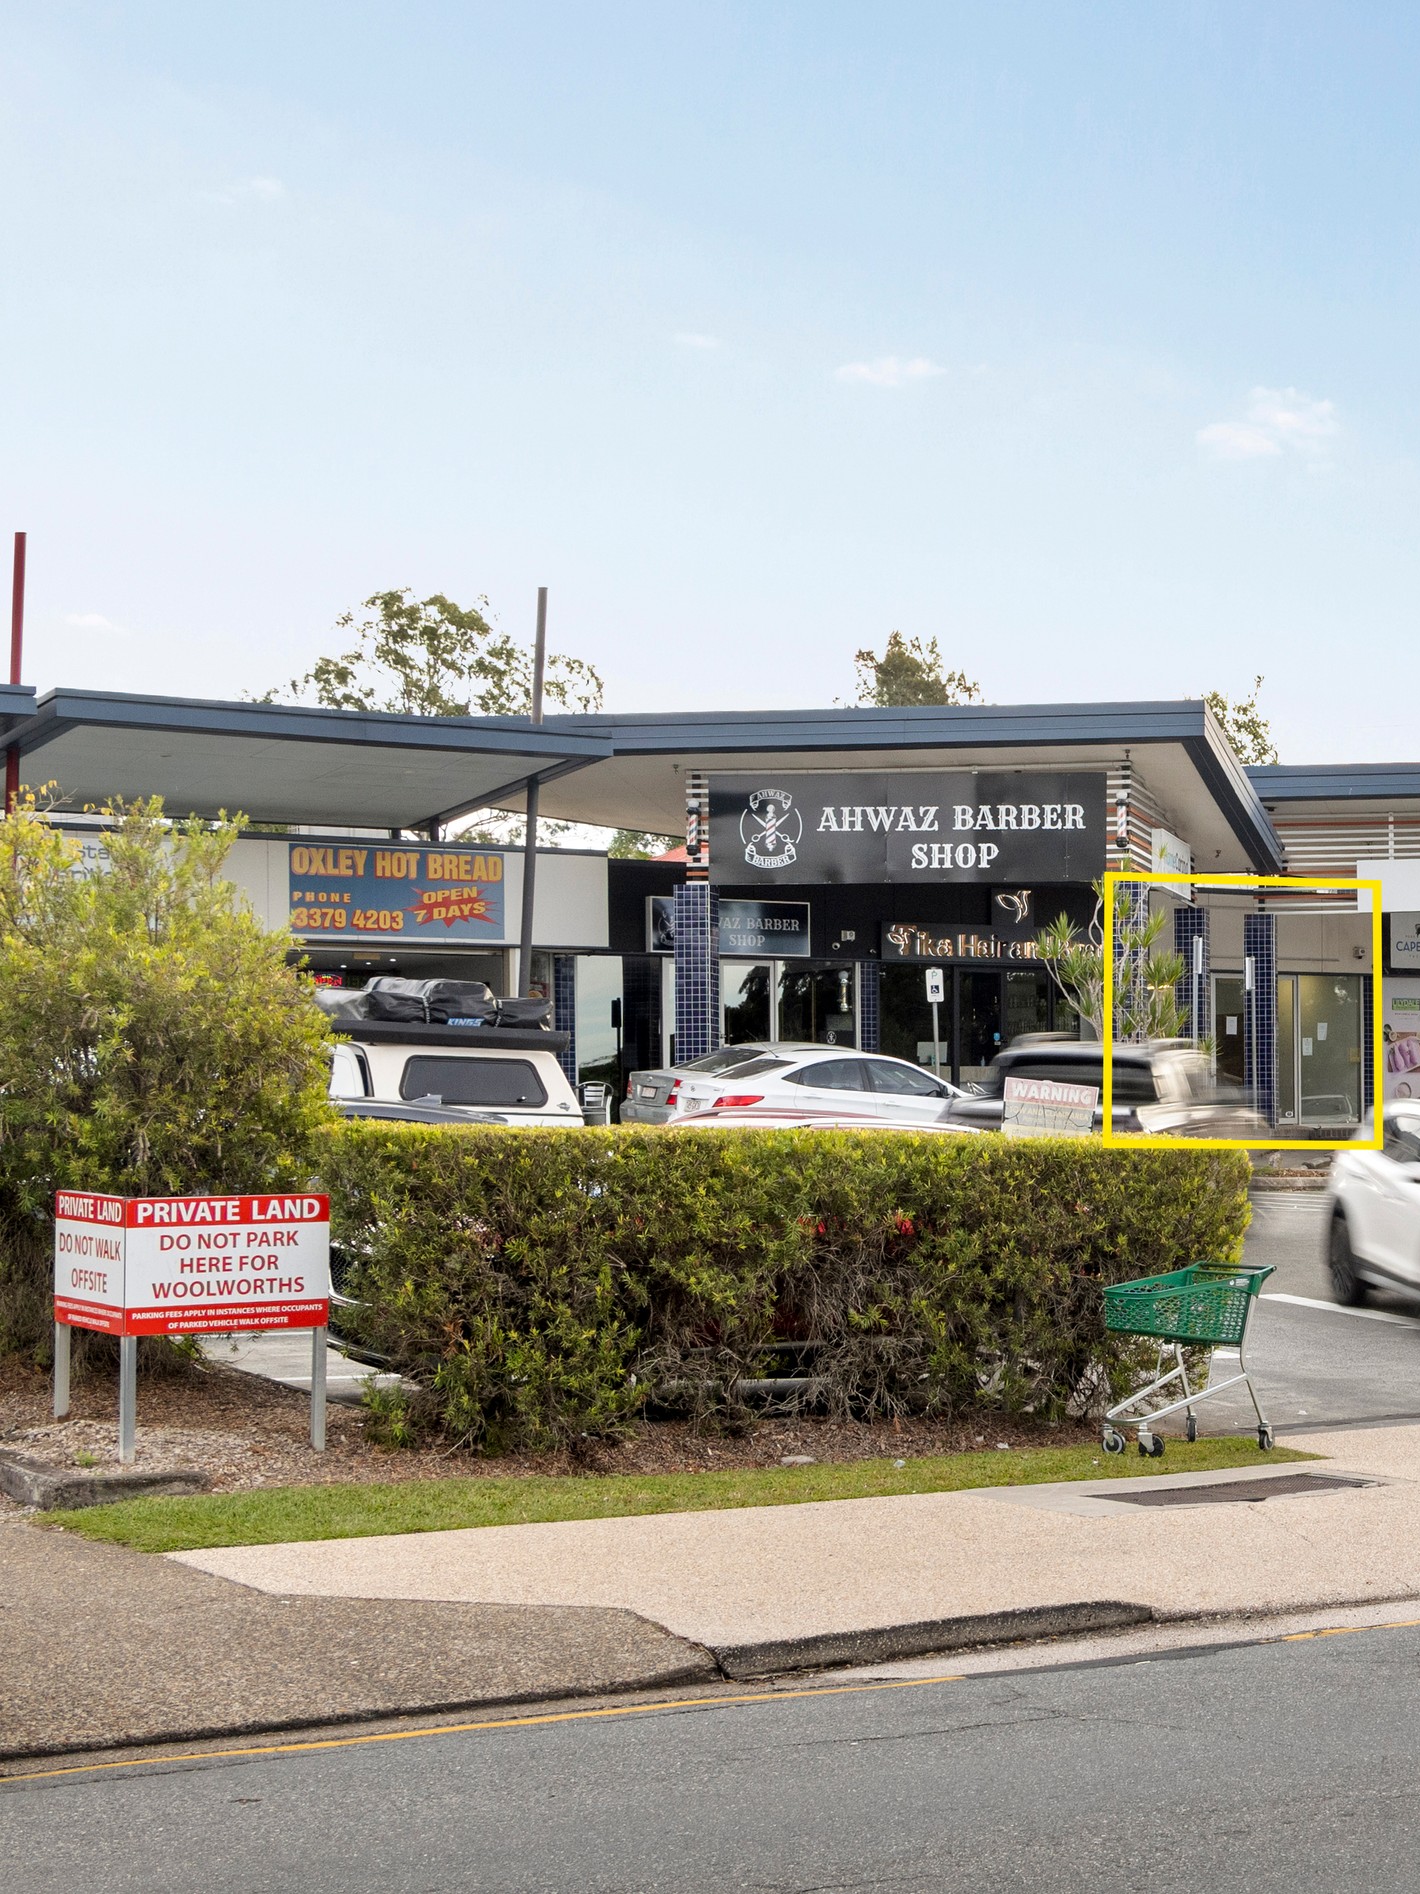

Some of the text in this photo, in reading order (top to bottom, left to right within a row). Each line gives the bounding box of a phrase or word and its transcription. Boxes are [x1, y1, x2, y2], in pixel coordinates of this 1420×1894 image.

[757, 790, 785, 799] AHWAZ
[817, 804, 1086, 832] AHWAZ BARBER
[291, 847, 503, 882] OXLEY HOT BREAD
[753, 855, 790, 867] BARBER
[911, 843, 1000, 869] SHOP
[292, 891, 352, 903] PHONE
[422, 886, 478, 904] OPEN
[293, 908, 404, 930] 3379 4203
[414, 902, 486, 923] 7 DAYS
[747, 918, 800, 931] BARBER
[729, 934, 766, 947] SHOP
[957, 934, 1007, 958] Hair
[447, 1017, 485, 1027] KINGS
[1012, 1083, 1092, 1105] WARNING
[59, 1195, 122, 1223] PRIVATE LAND
[137, 1198, 320, 1224] PRIVATE LAND
[59, 1232, 121, 1262] DO NOT WALK
[160, 1230, 299, 1251] DO NOT PARK
[180, 1254, 279, 1274] HERE FOR
[71, 1268, 108, 1293] OFFSITE
[152, 1276, 305, 1299] WOOLWORTHS
[132, 1303, 323, 1320] PARKING FEES APPLY IN INSTANCES WHERE OCCUPANTS
[179, 1321, 208, 1329] PARKED
[208, 1319, 239, 1327] VEHICLE
[239, 1318, 260, 1326] WALK
[260, 1316, 288, 1325] OFFSITE
